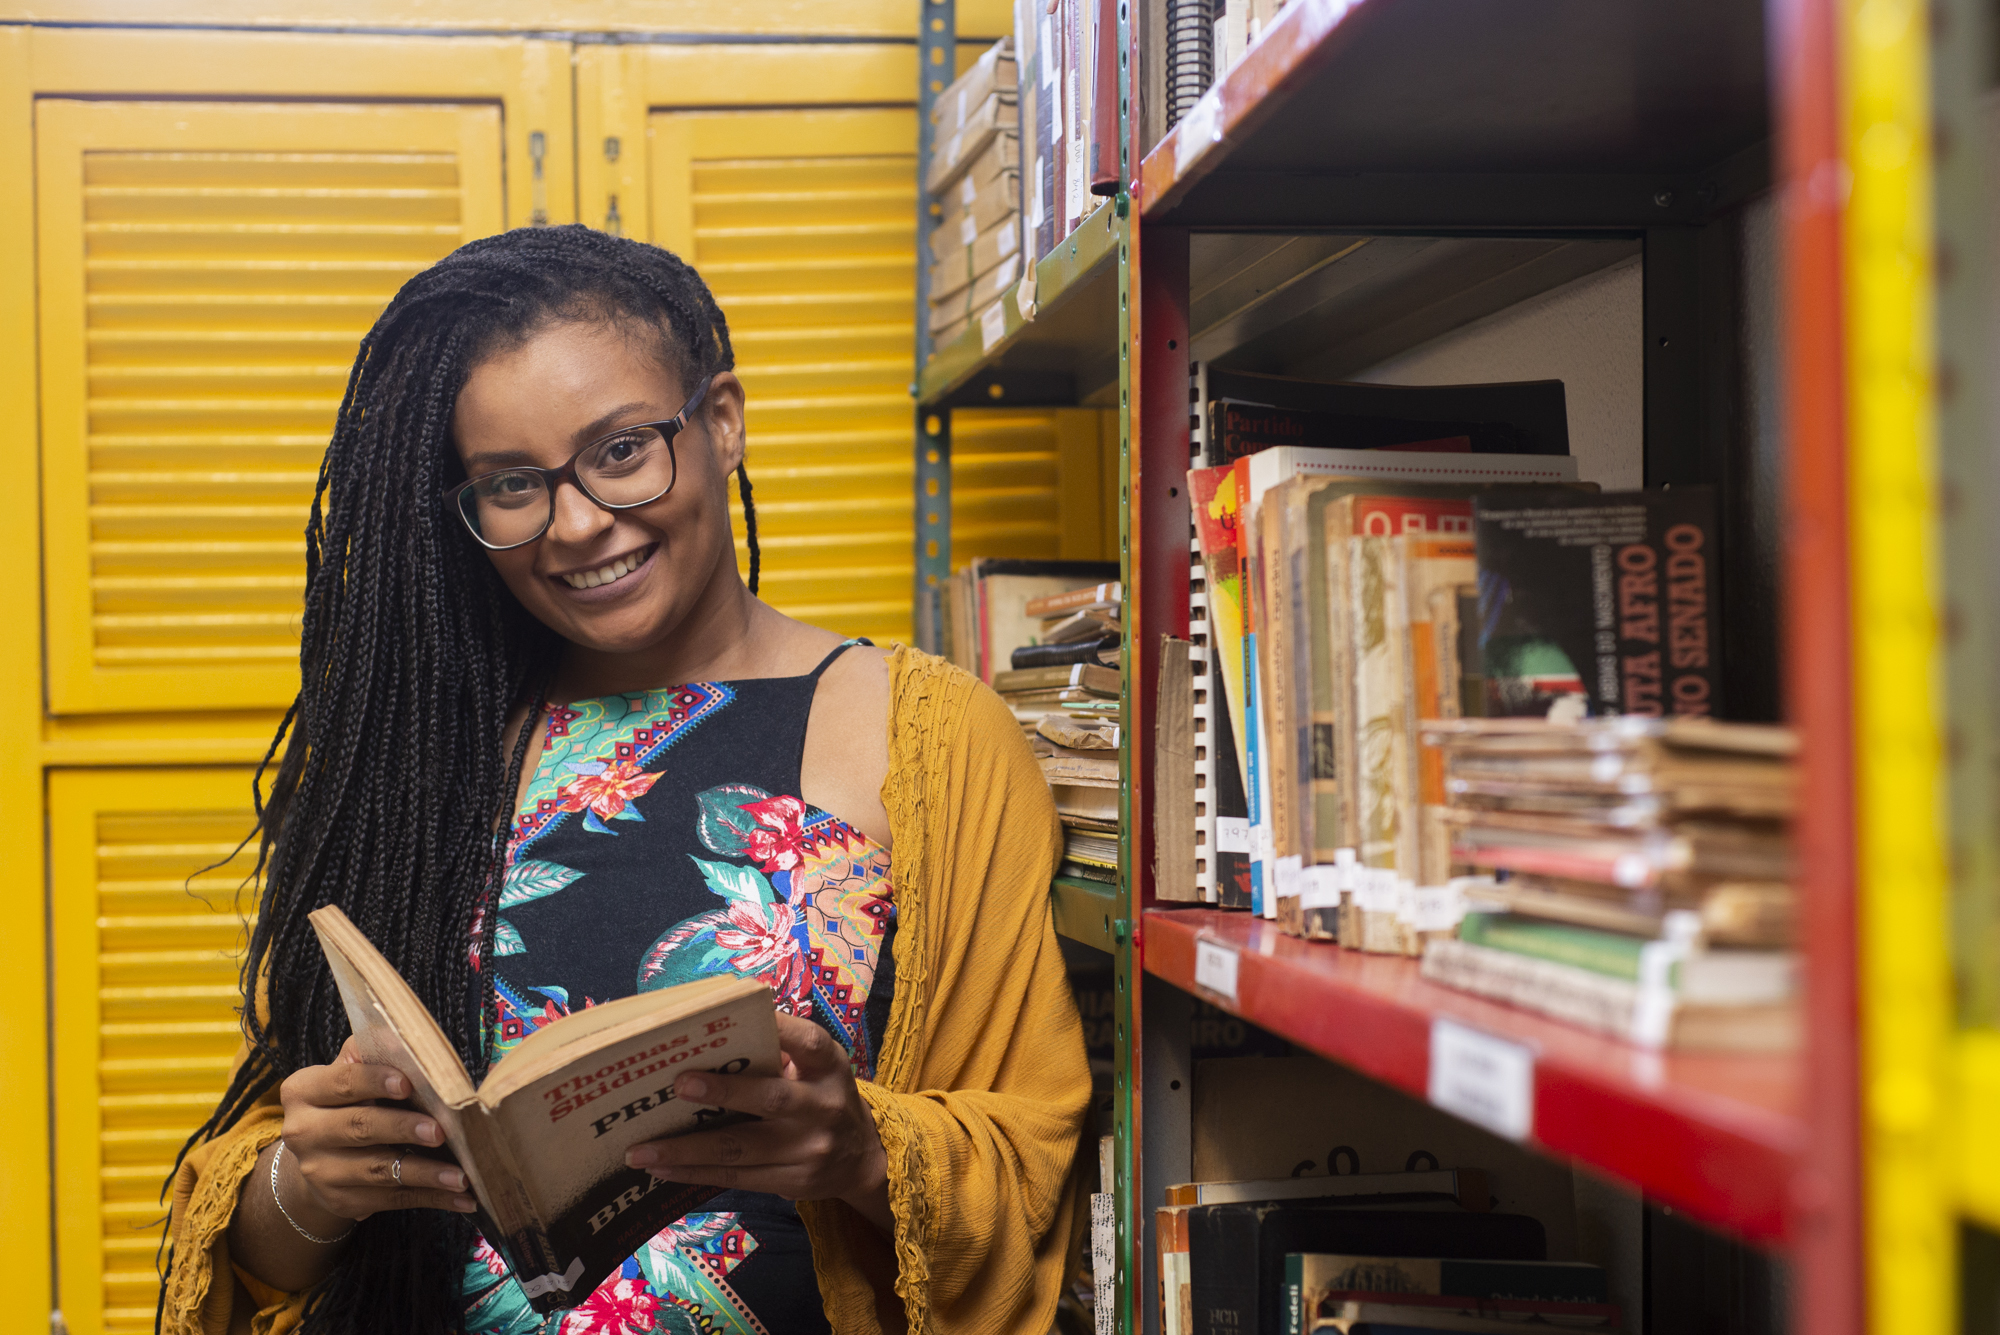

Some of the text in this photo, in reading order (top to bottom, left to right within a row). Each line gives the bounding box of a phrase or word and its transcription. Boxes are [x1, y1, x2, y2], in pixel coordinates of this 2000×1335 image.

[1226, 410, 1304, 437] Partido
[1590, 544, 1615, 628] NASCIMENTO
[1616, 543, 1661, 644] AFRO
[1663, 523, 1709, 669] SENADO
[544, 1034, 689, 1105] Thomas
[703, 1016, 738, 1037] E.
[549, 1036, 728, 1124] Skidmore
[590, 1057, 750, 1139] PREO
[612, 1251, 626, 1265] NO
[629, 1201, 692, 1248] PENSAMENTO
[1288, 1284, 1299, 1335] Fedeli
